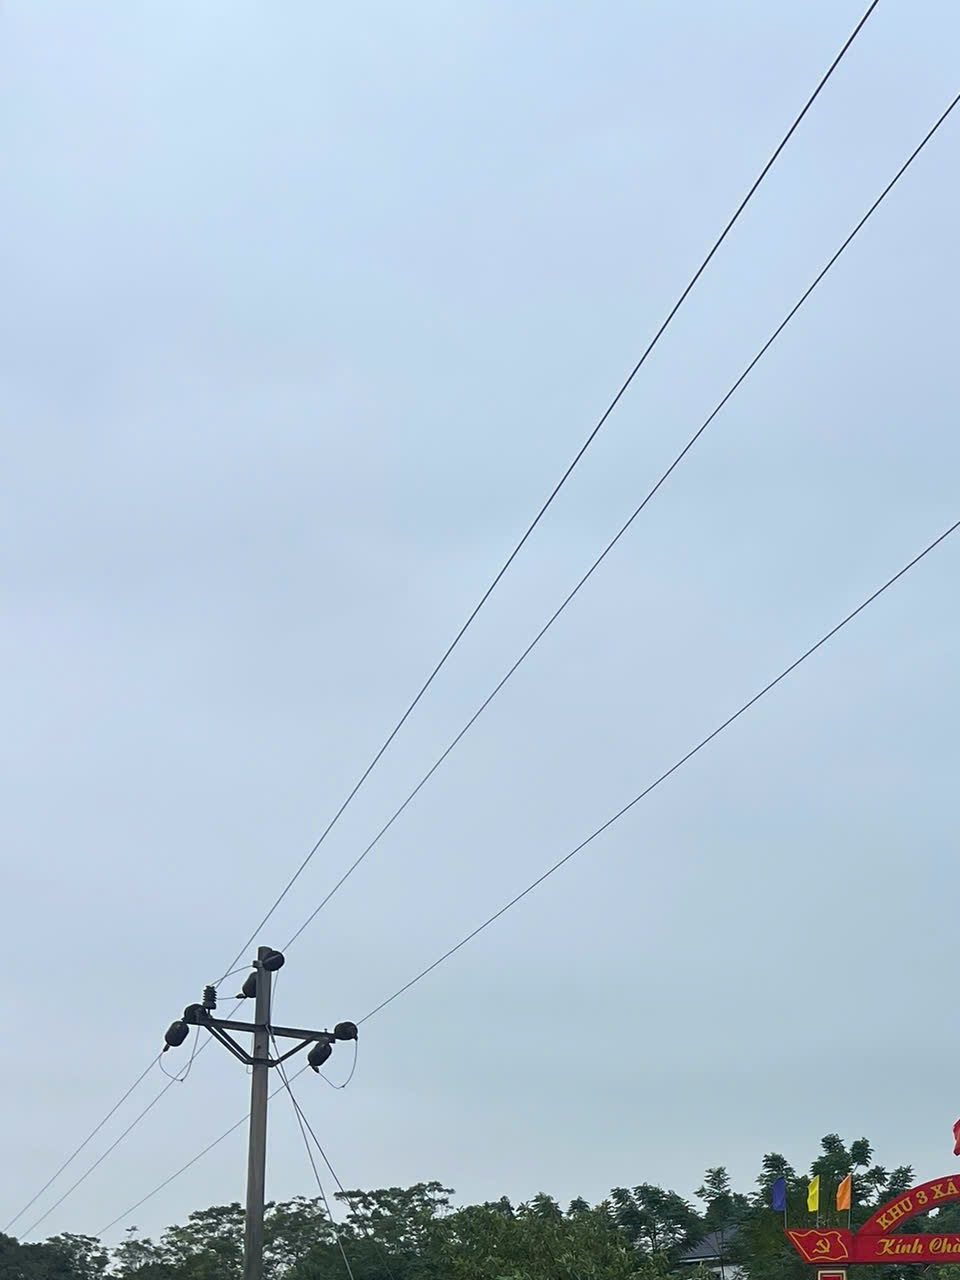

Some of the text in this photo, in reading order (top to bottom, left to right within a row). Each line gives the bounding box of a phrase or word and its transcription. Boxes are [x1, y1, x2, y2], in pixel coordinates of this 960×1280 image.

[876, 1197, 913, 1229] KHU
[916, 1190, 928, 1204] 3
[931, 1179, 959, 1200] XÃ
[875, 1238, 923, 1255] Kính
